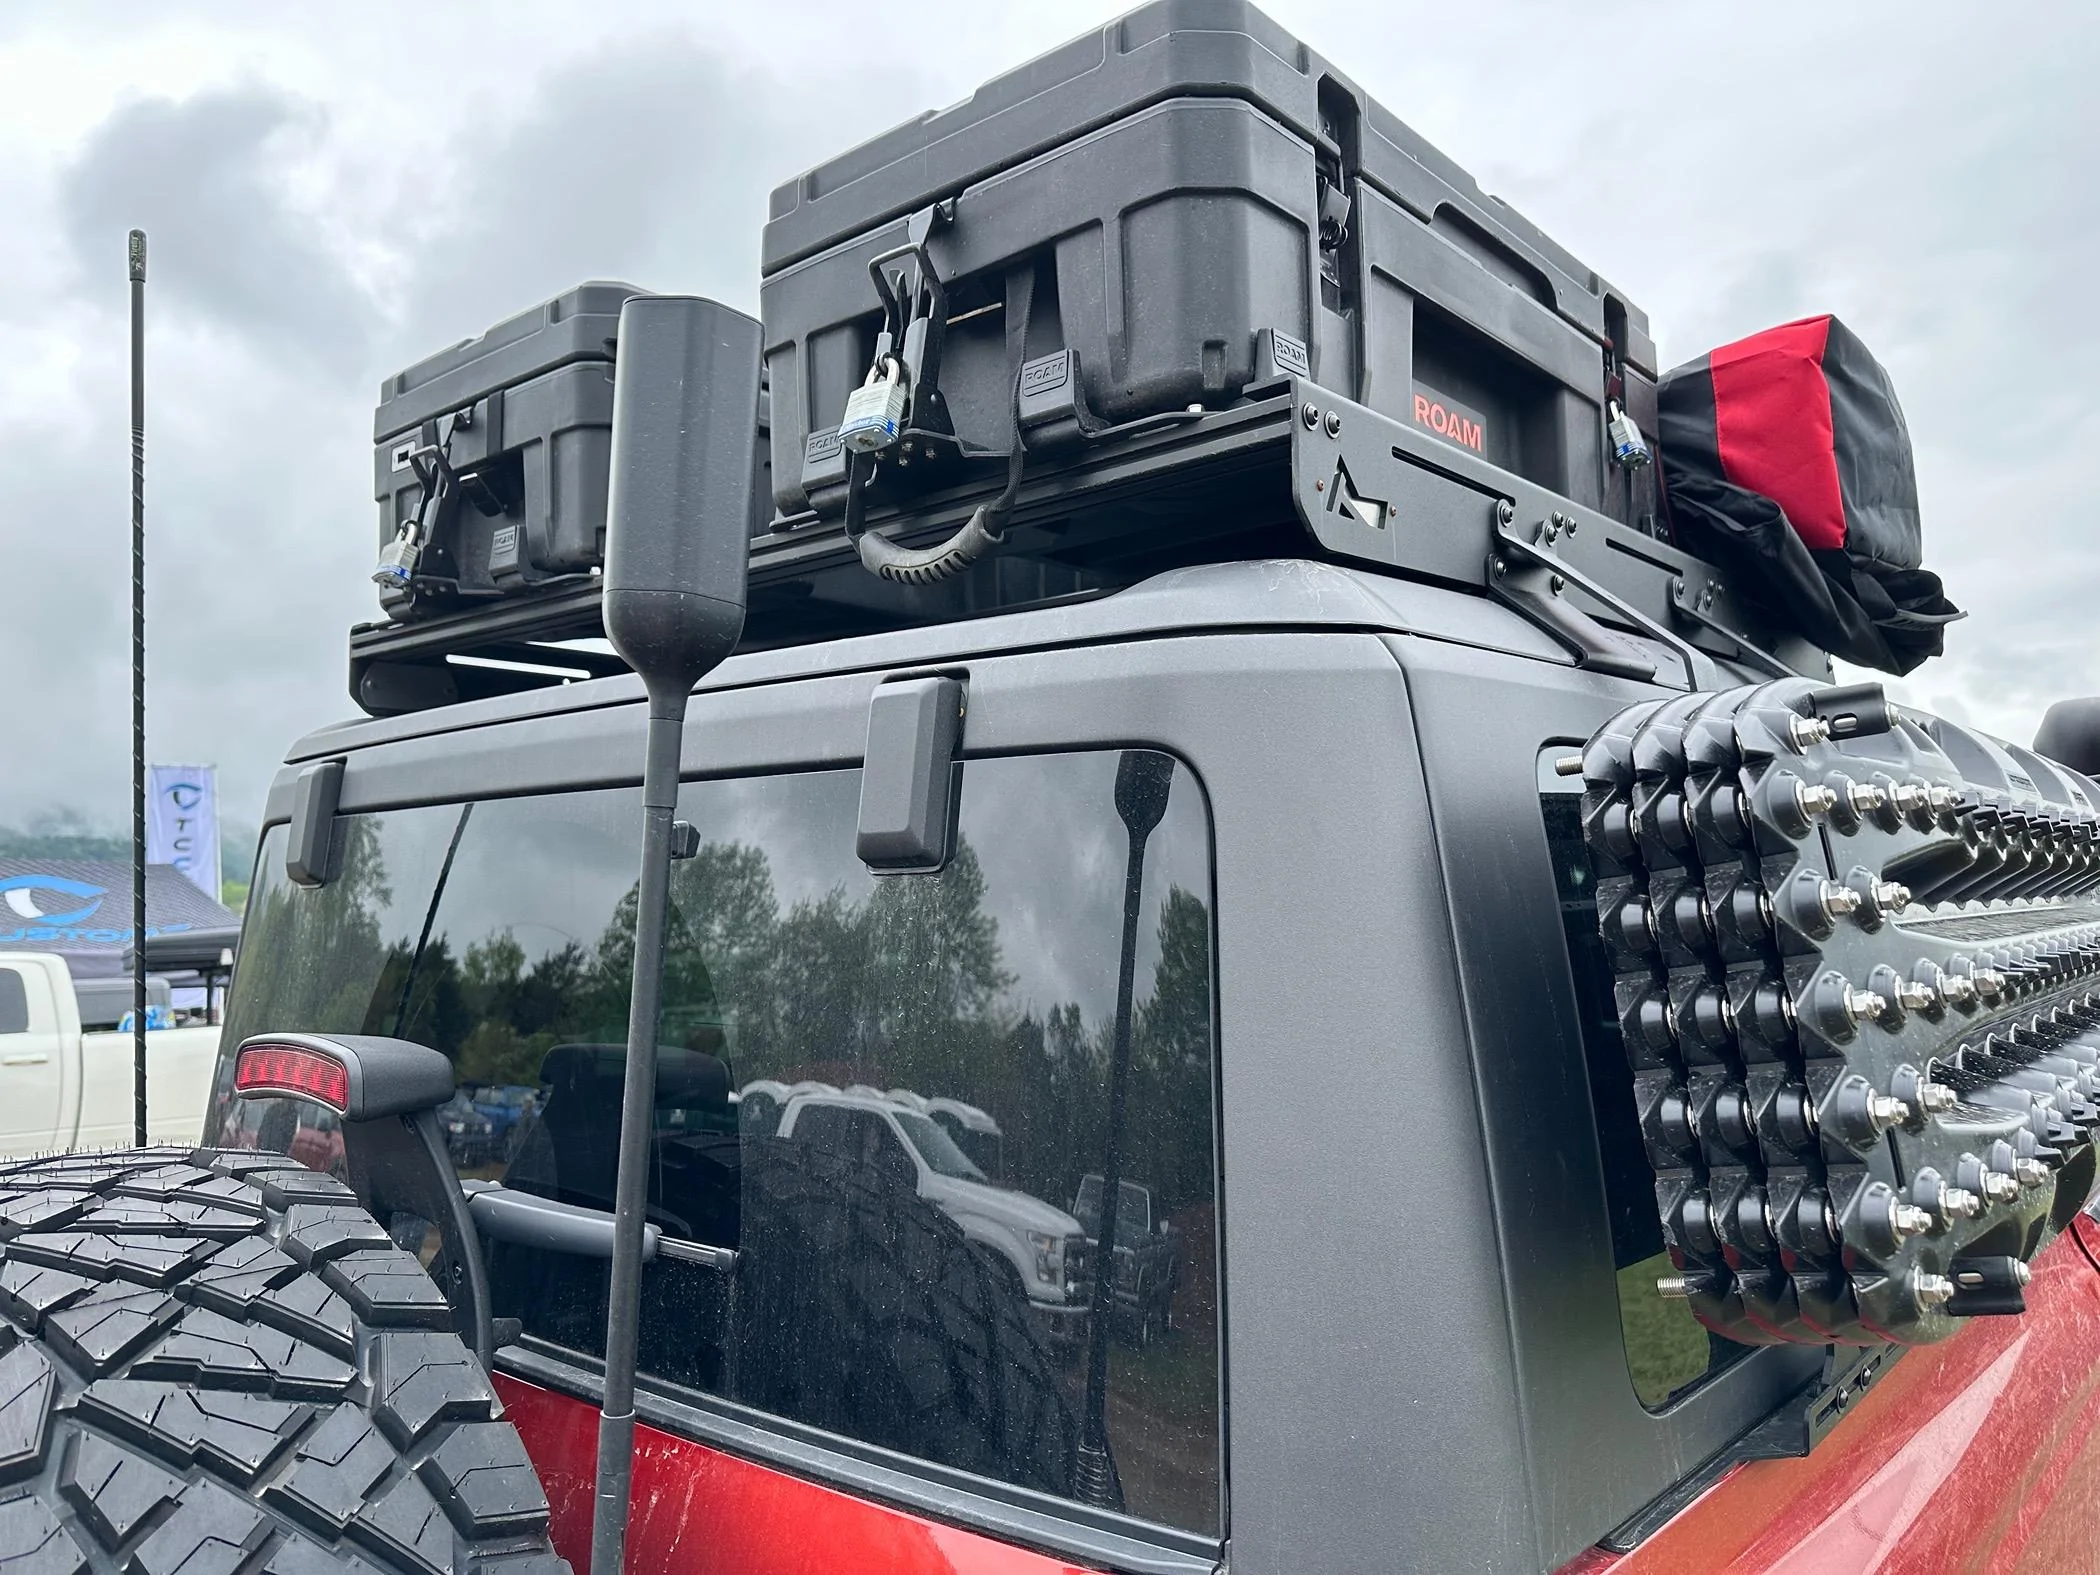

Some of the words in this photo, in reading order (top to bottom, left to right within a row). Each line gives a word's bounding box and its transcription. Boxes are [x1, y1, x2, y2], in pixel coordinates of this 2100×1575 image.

[1276, 341, 1306, 364] ROAM
[1025, 361, 1065, 384] ROAM
[1414, 393, 1482, 452] ROAM
